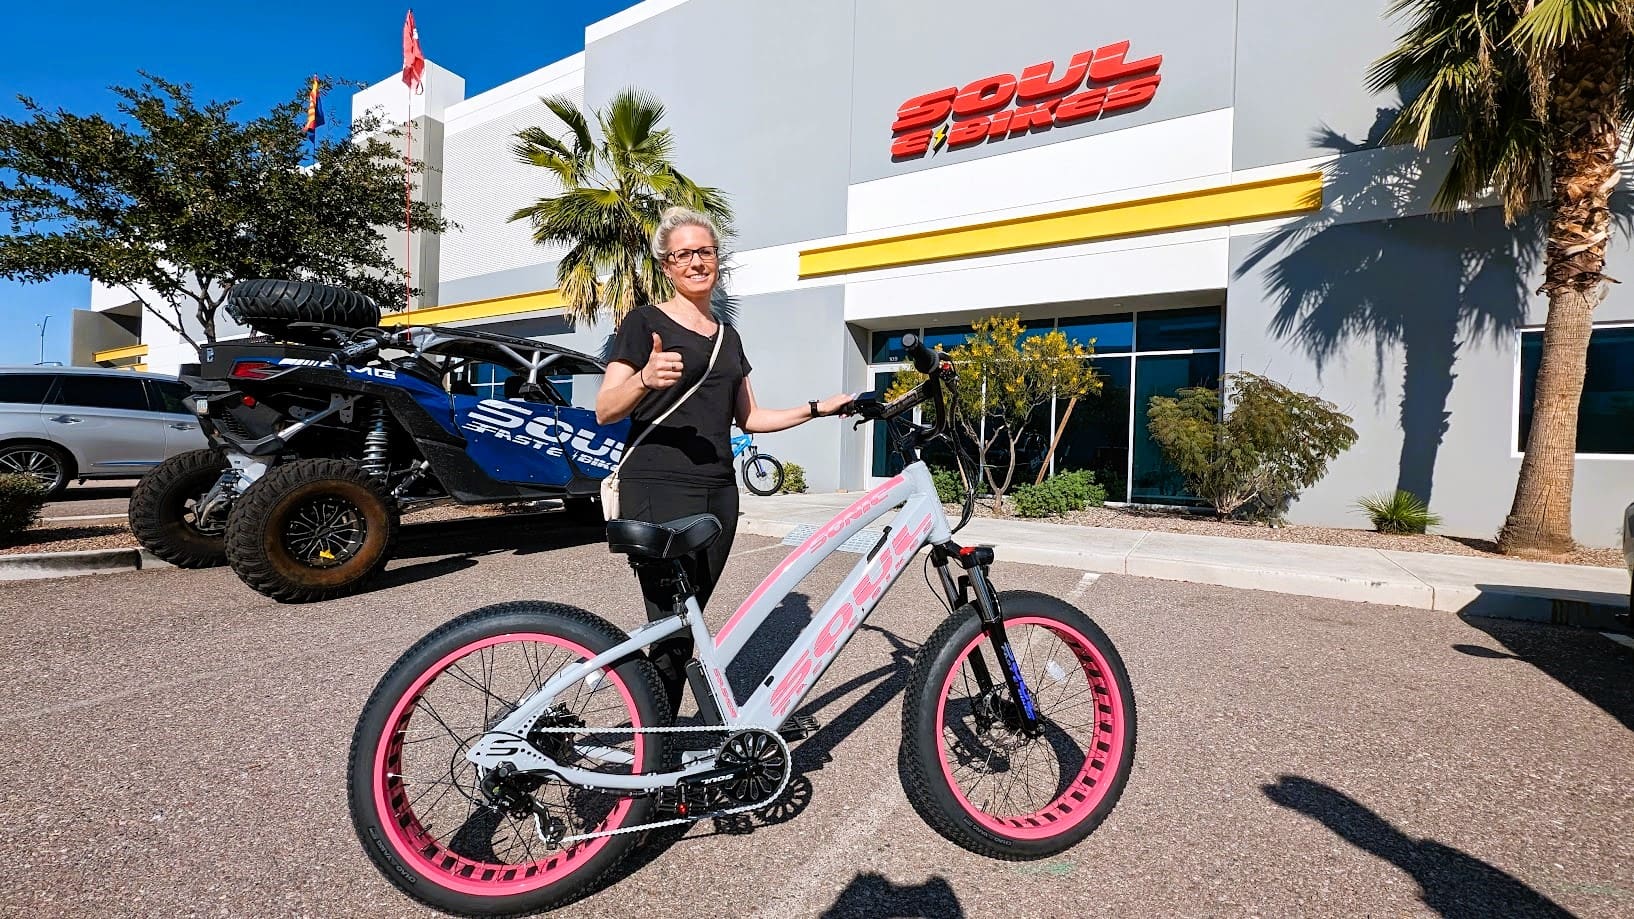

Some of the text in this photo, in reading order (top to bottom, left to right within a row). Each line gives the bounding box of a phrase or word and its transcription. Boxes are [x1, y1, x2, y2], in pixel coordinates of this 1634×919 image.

[891, 39, 1163, 136] SOUL
[946, 74, 1162, 152] BIKES
[809, 487, 889, 554] SONIC
[769, 512, 932, 717] SOUL
[701, 773, 734, 785] SOUL
